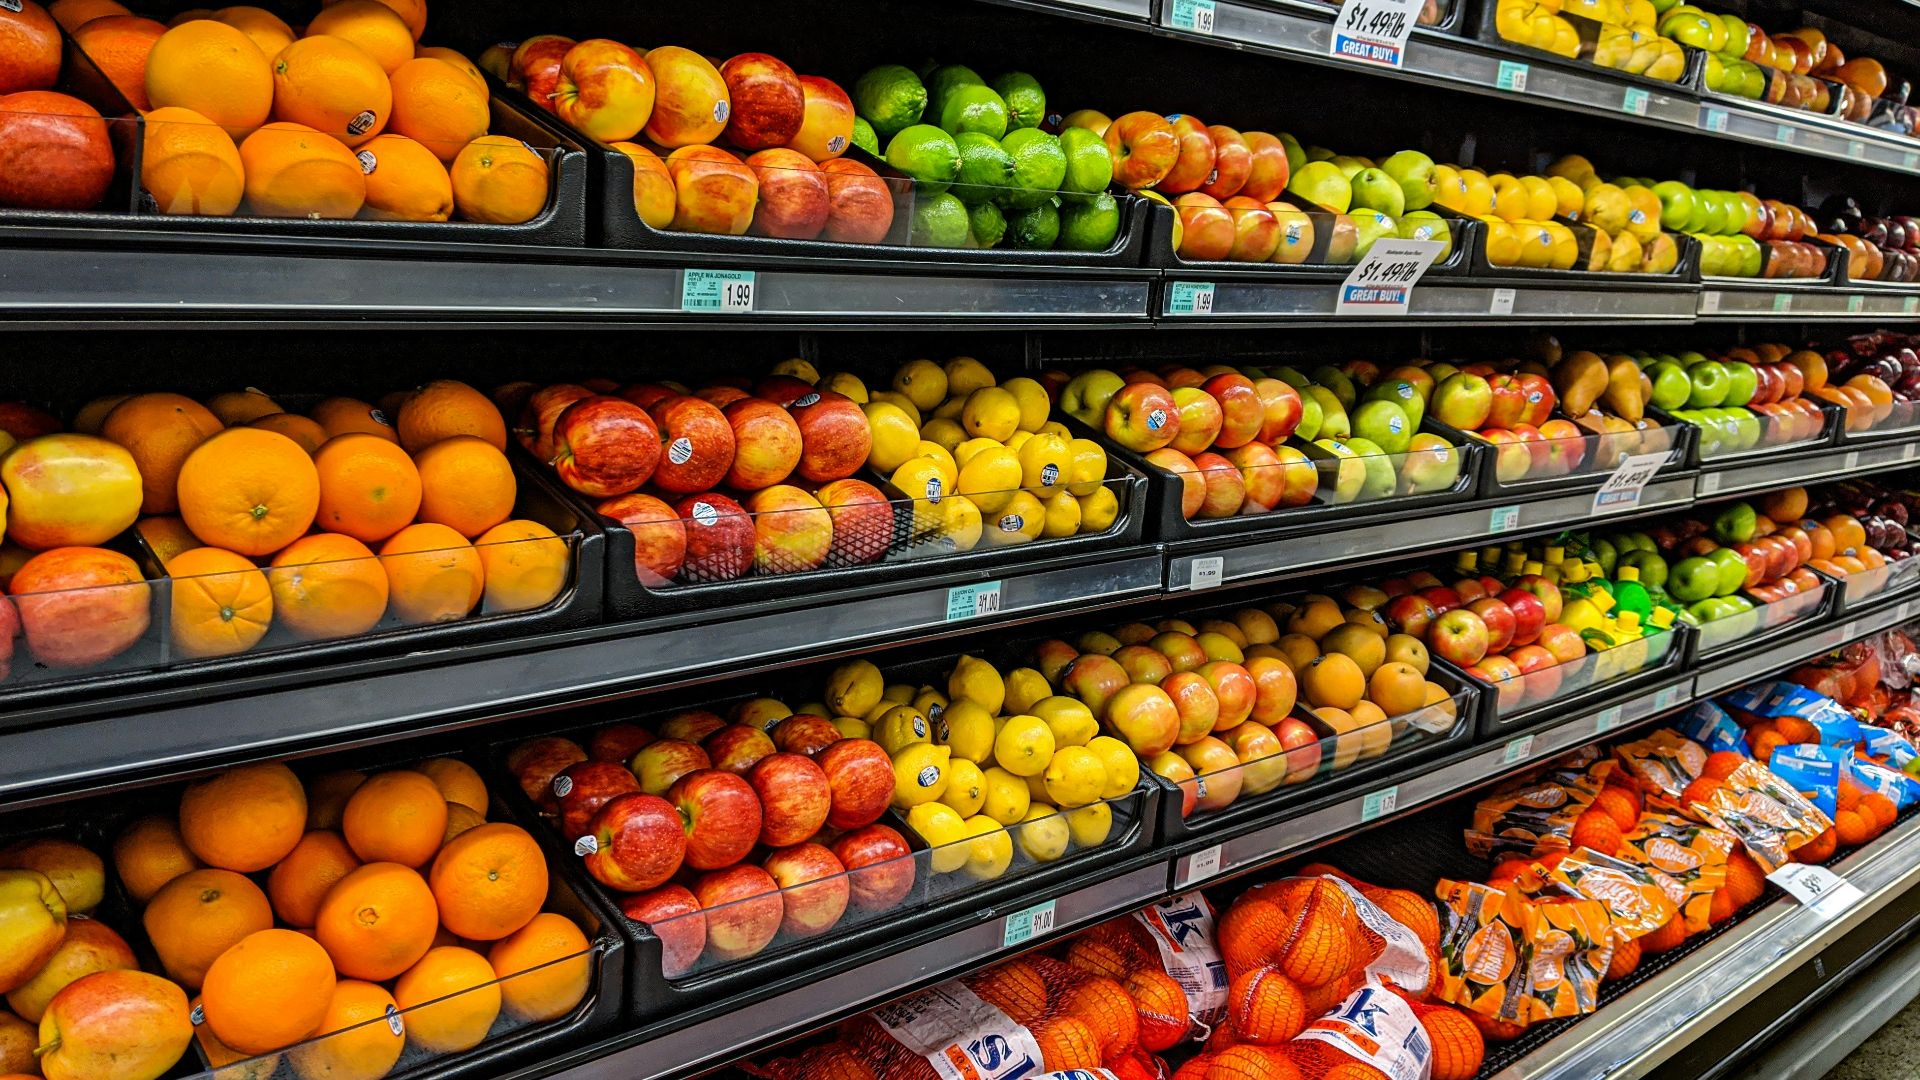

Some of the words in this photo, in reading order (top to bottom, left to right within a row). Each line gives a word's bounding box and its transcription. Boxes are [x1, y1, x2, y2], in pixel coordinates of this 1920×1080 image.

[1197, 11, 1212, 31] 1.99
[1346, 2, 1391, 35] $1.49
[1342, 39, 1371, 58] GREAT
[1371, 45, 1394, 62] BUY!
[1357, 259, 1405, 283] $1.49
[727, 284, 751, 306] 1.99
[1196, 292, 1212, 311] 1.99
[1350, 289, 1379, 302] GREAT
[1379, 290, 1401, 302] BUY!
